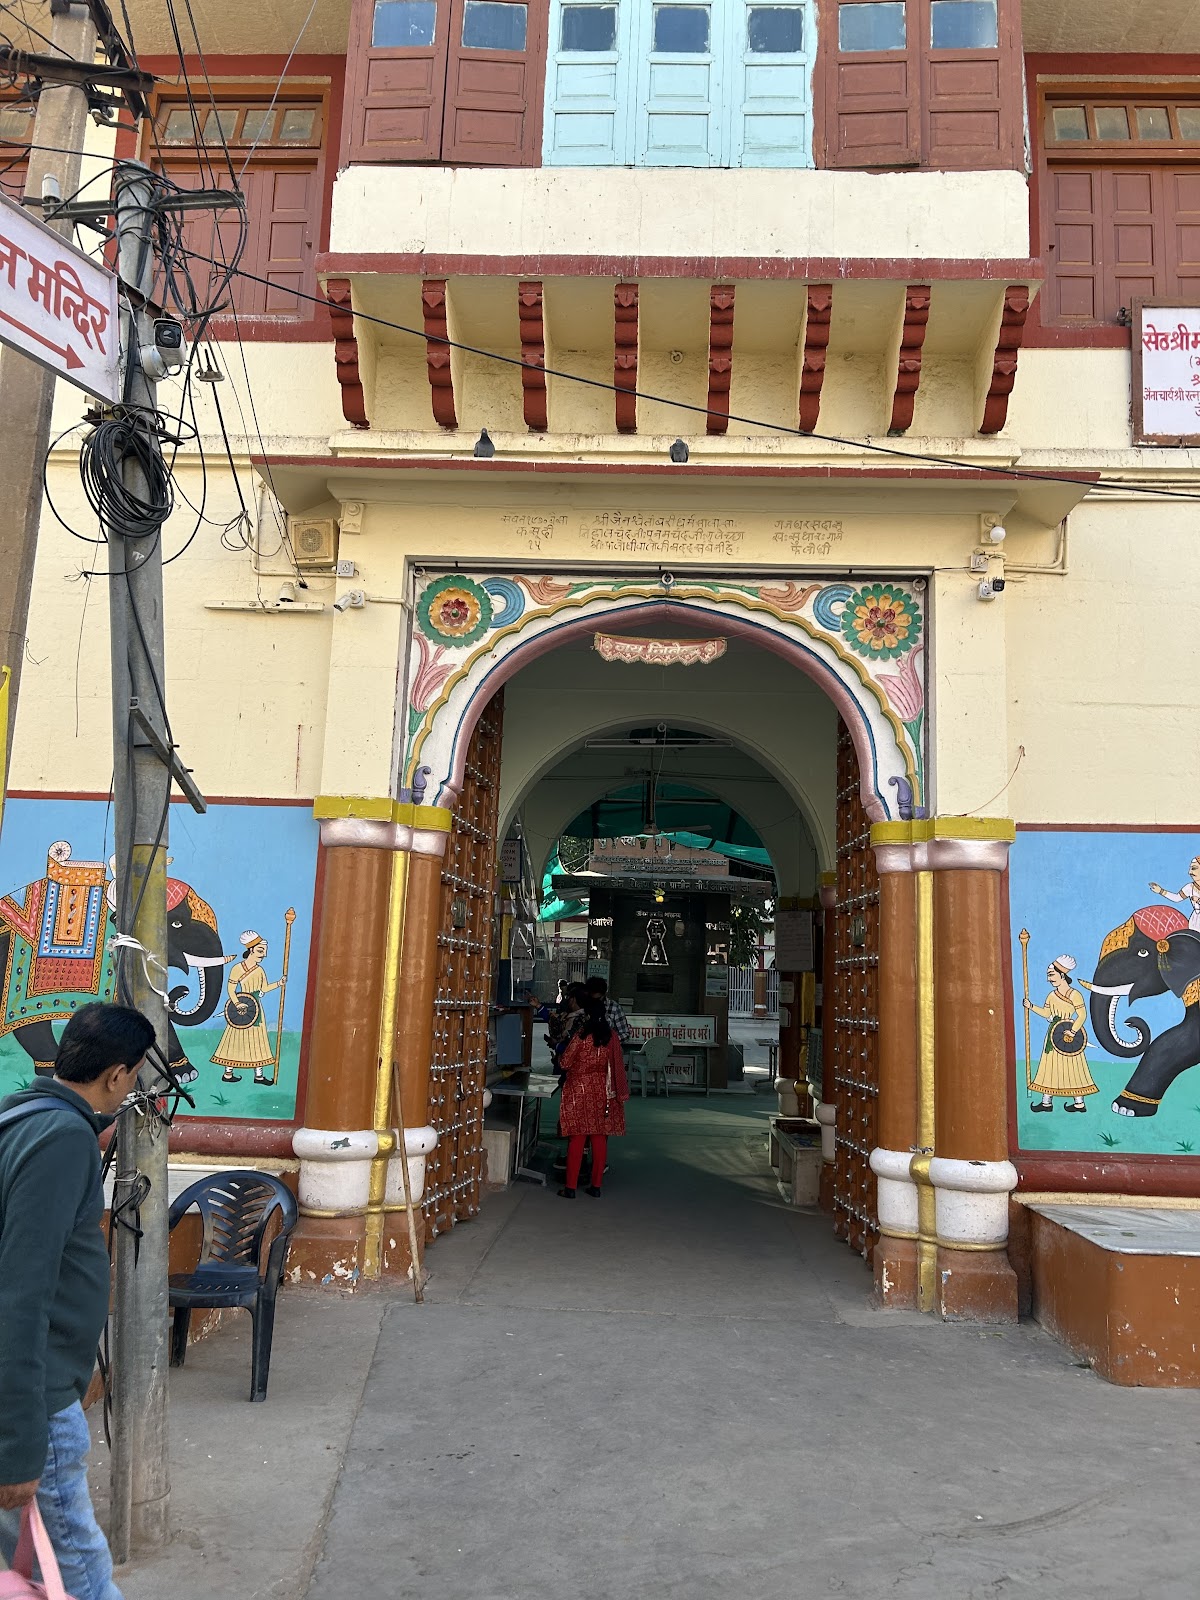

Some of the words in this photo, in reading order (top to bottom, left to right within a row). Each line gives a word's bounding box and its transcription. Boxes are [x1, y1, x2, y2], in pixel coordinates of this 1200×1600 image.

[27, 252, 110, 356] मन्दिर
[1142, 323, 1170, 352] सेठ
[1171, 323, 1191, 351] श्री
[1174, 386, 1185, 401] श्री
